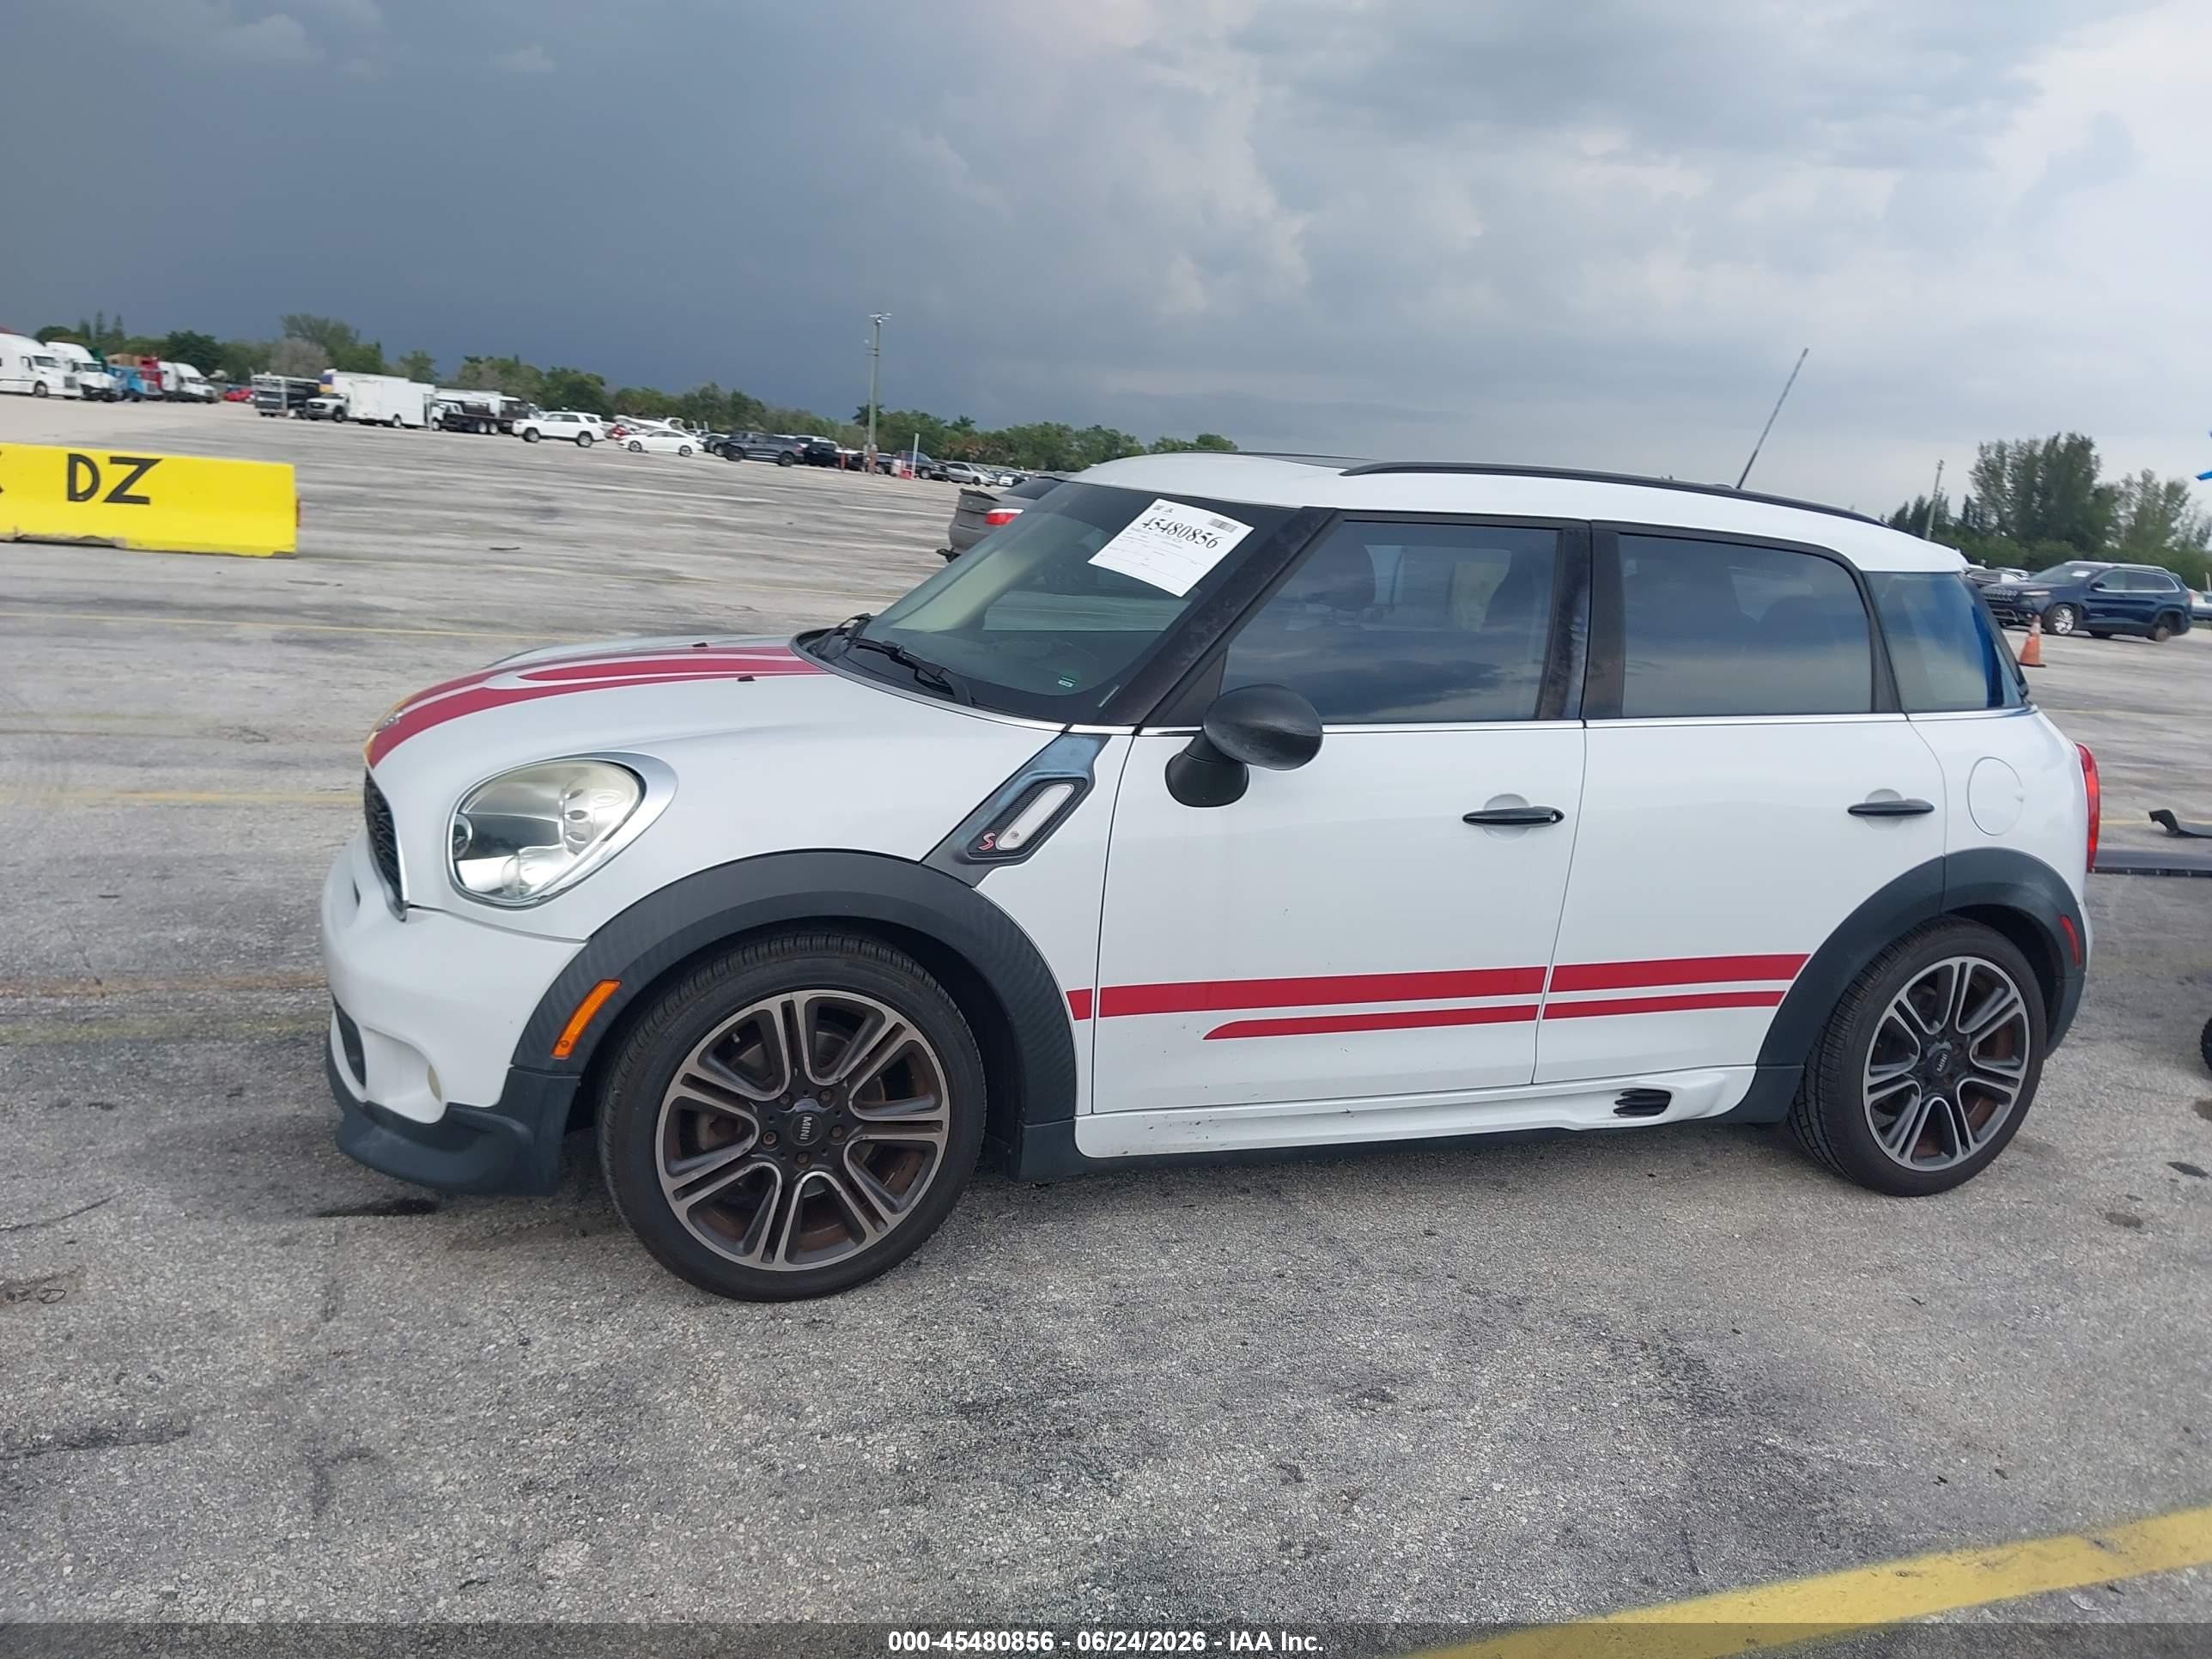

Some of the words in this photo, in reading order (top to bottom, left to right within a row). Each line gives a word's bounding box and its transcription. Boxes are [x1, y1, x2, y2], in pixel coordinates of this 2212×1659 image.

[67, 453, 162, 505] DZ
[1141, 517, 1224, 549] 45480856
[977, 831, 997, 851] S
[799, 1116, 812, 1140] MINI
